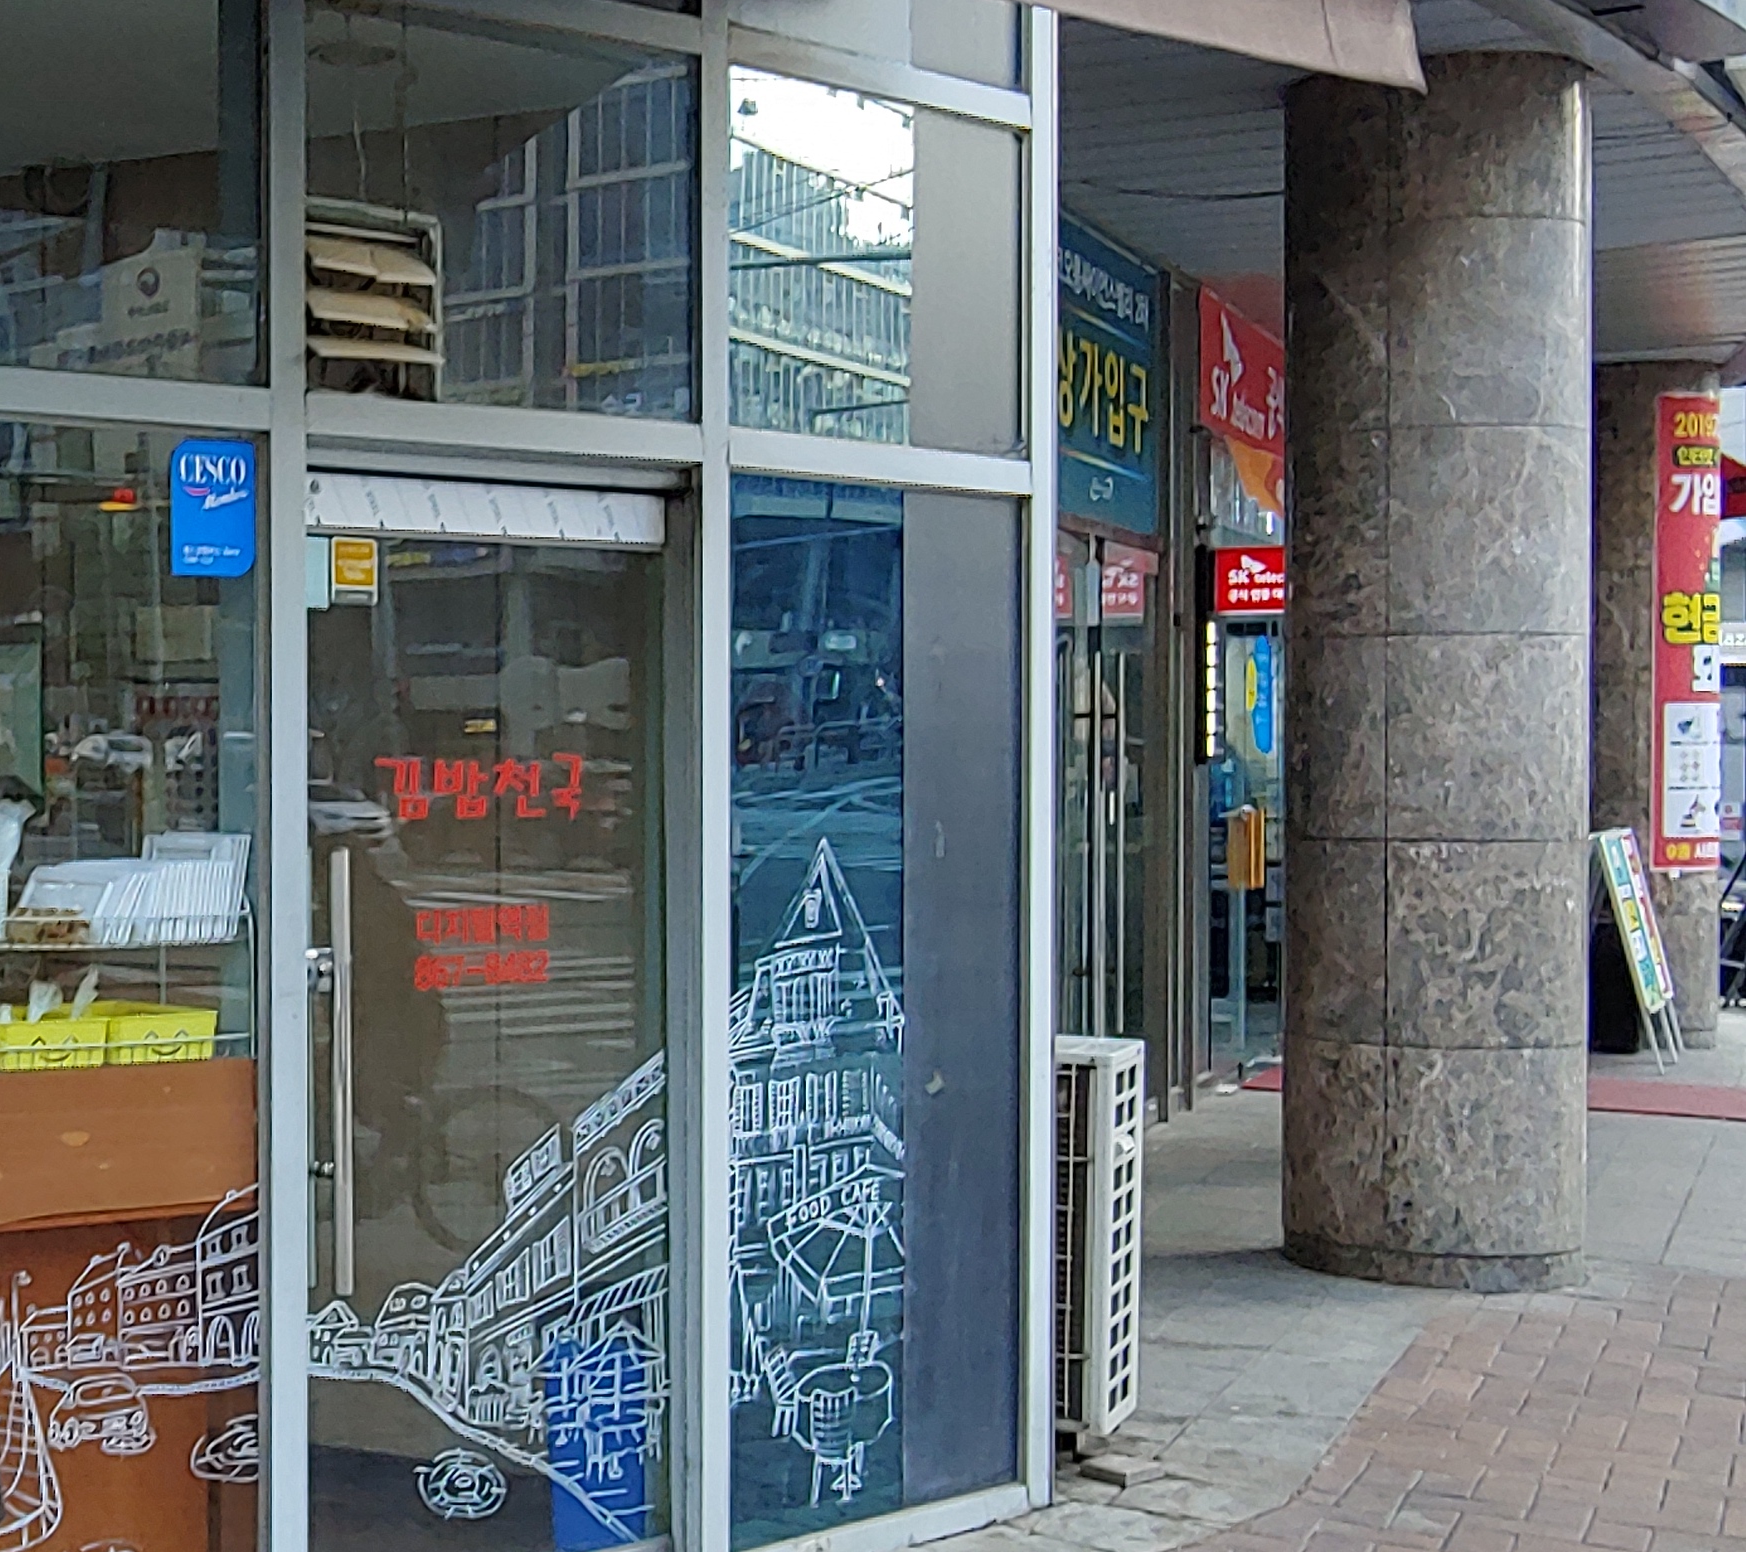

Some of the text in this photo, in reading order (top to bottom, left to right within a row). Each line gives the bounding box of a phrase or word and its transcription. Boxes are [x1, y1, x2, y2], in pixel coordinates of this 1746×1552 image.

[1057, 328, 1150, 456] 상가입구
[179, 452, 246, 485] CESCO
[1228, 569, 1250, 585] SK
[373, 751, 583, 821] 김밥천국
[413, 948, 550, 993] 867-8482
